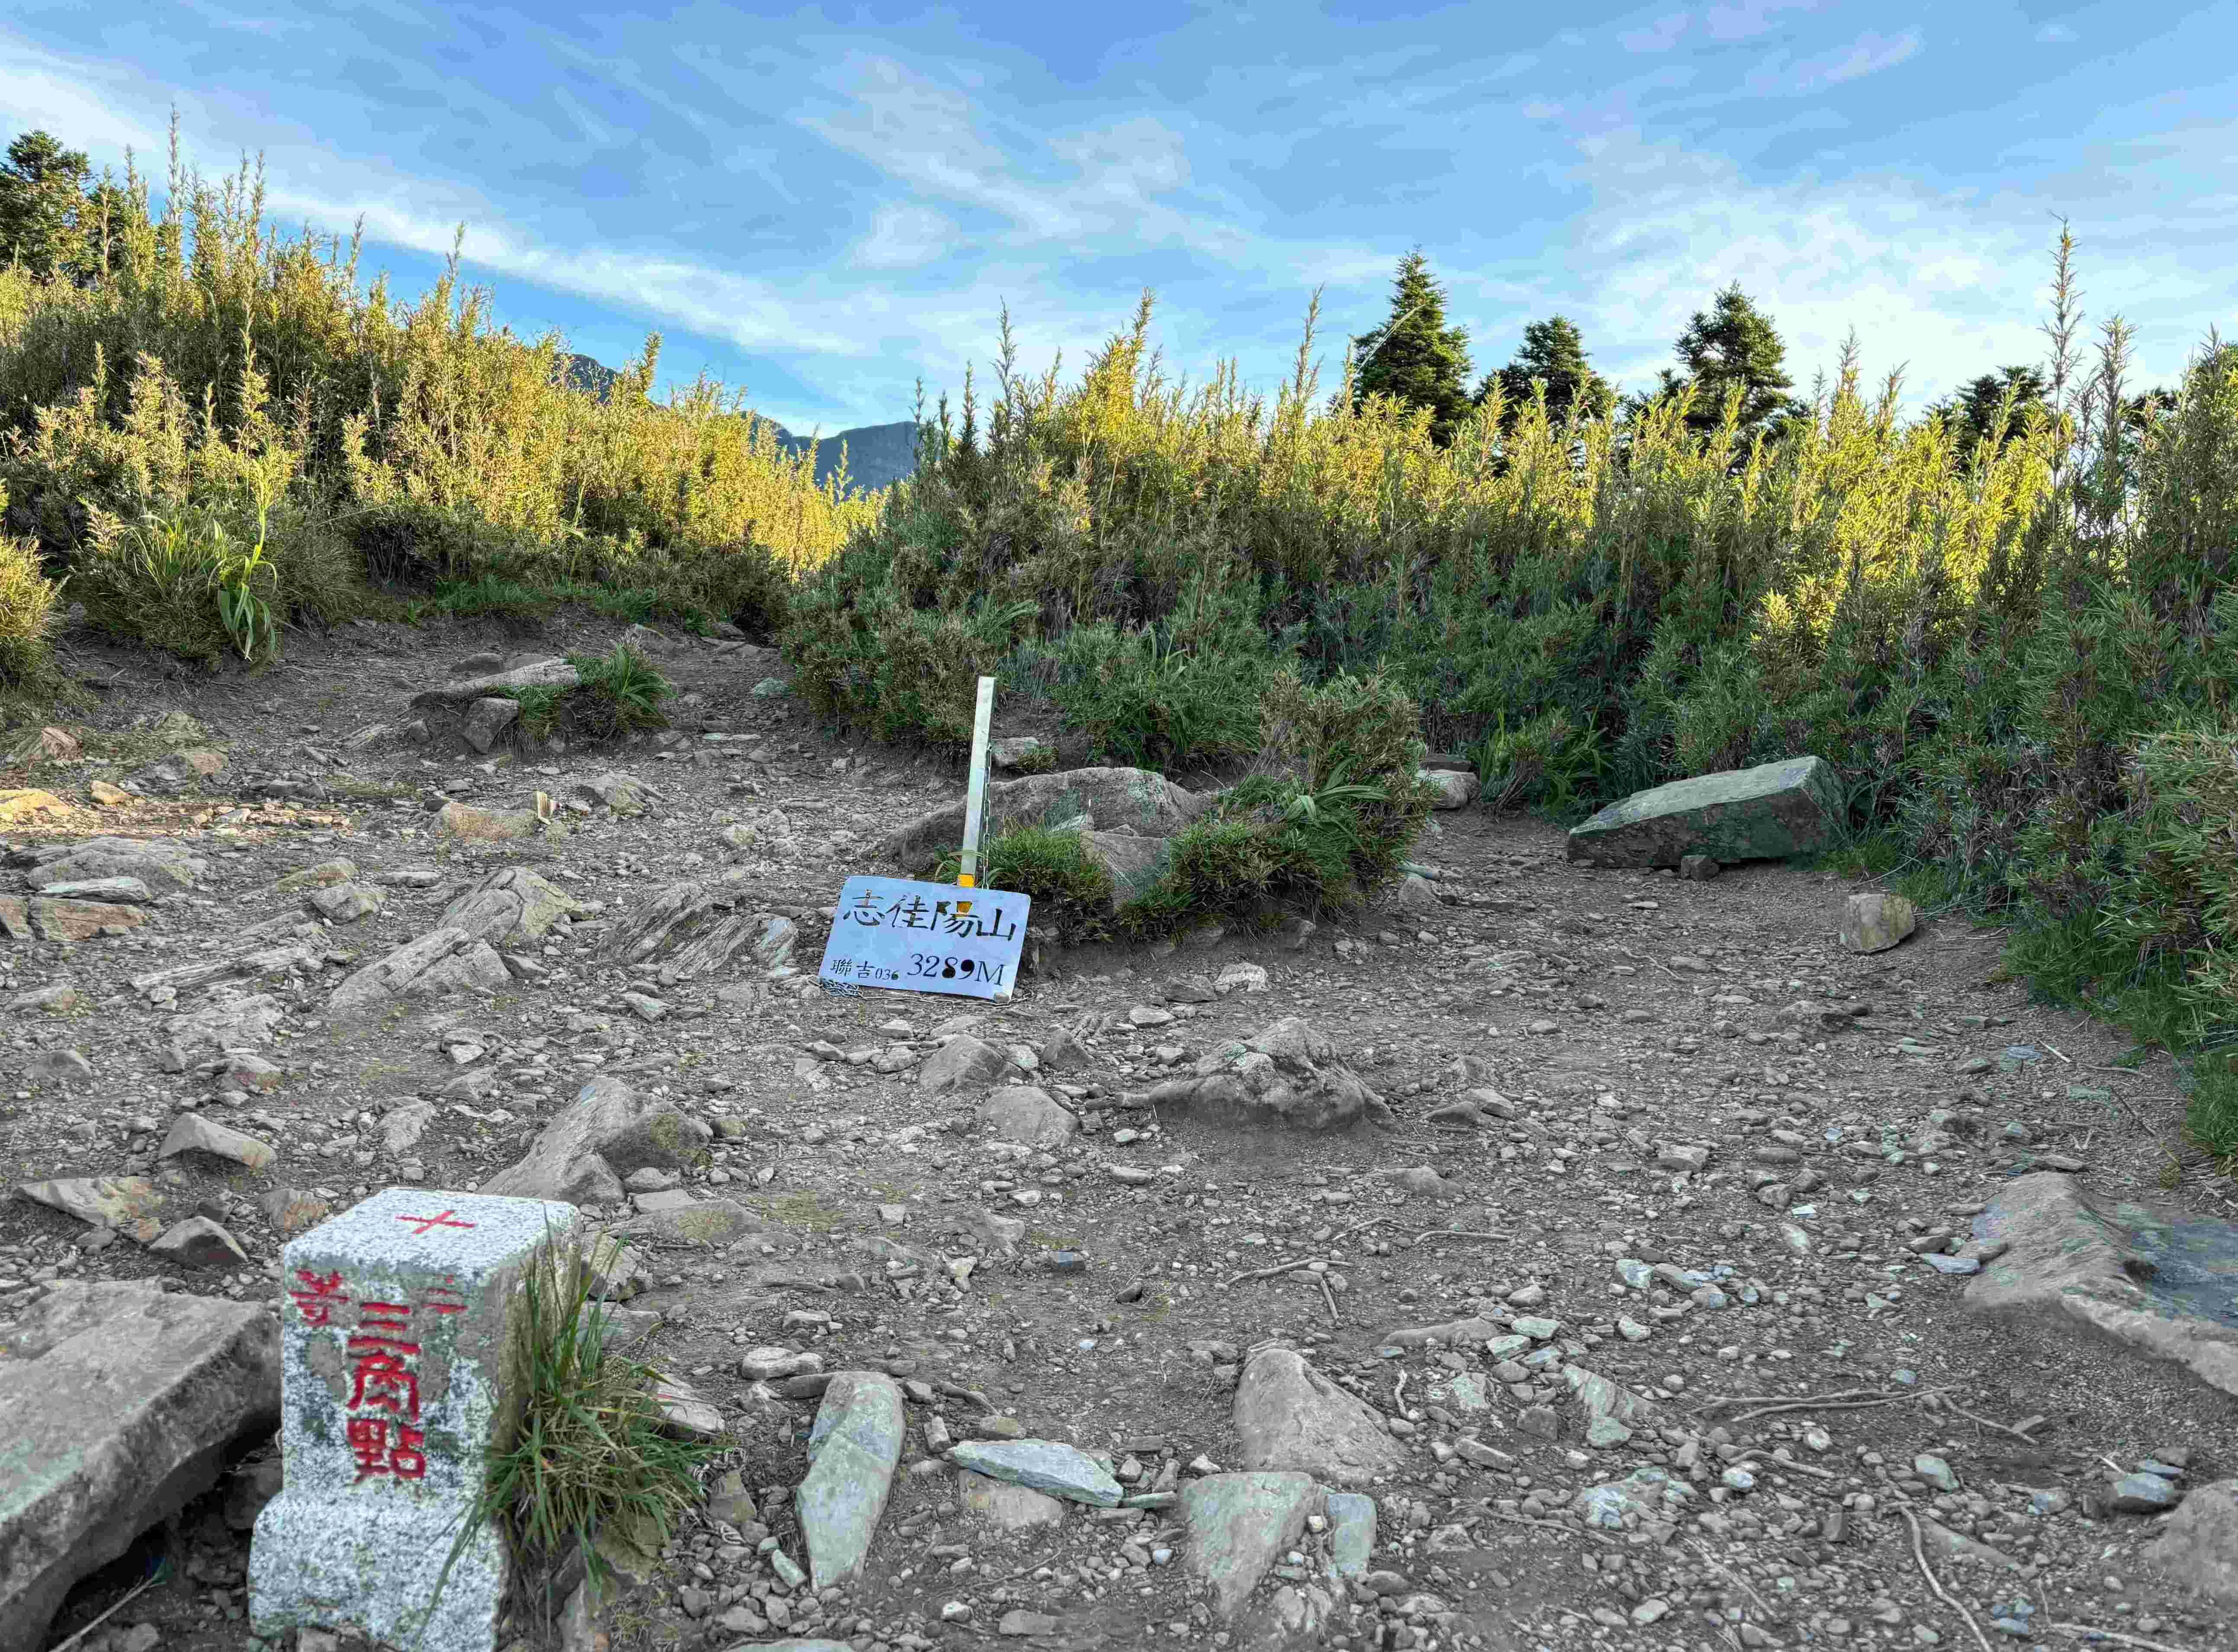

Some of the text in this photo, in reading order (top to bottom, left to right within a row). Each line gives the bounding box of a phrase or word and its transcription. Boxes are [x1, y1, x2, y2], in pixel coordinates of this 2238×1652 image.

[843, 890, 1016, 941] 志佳陽山
[907, 953, 1004, 986] 3289M
